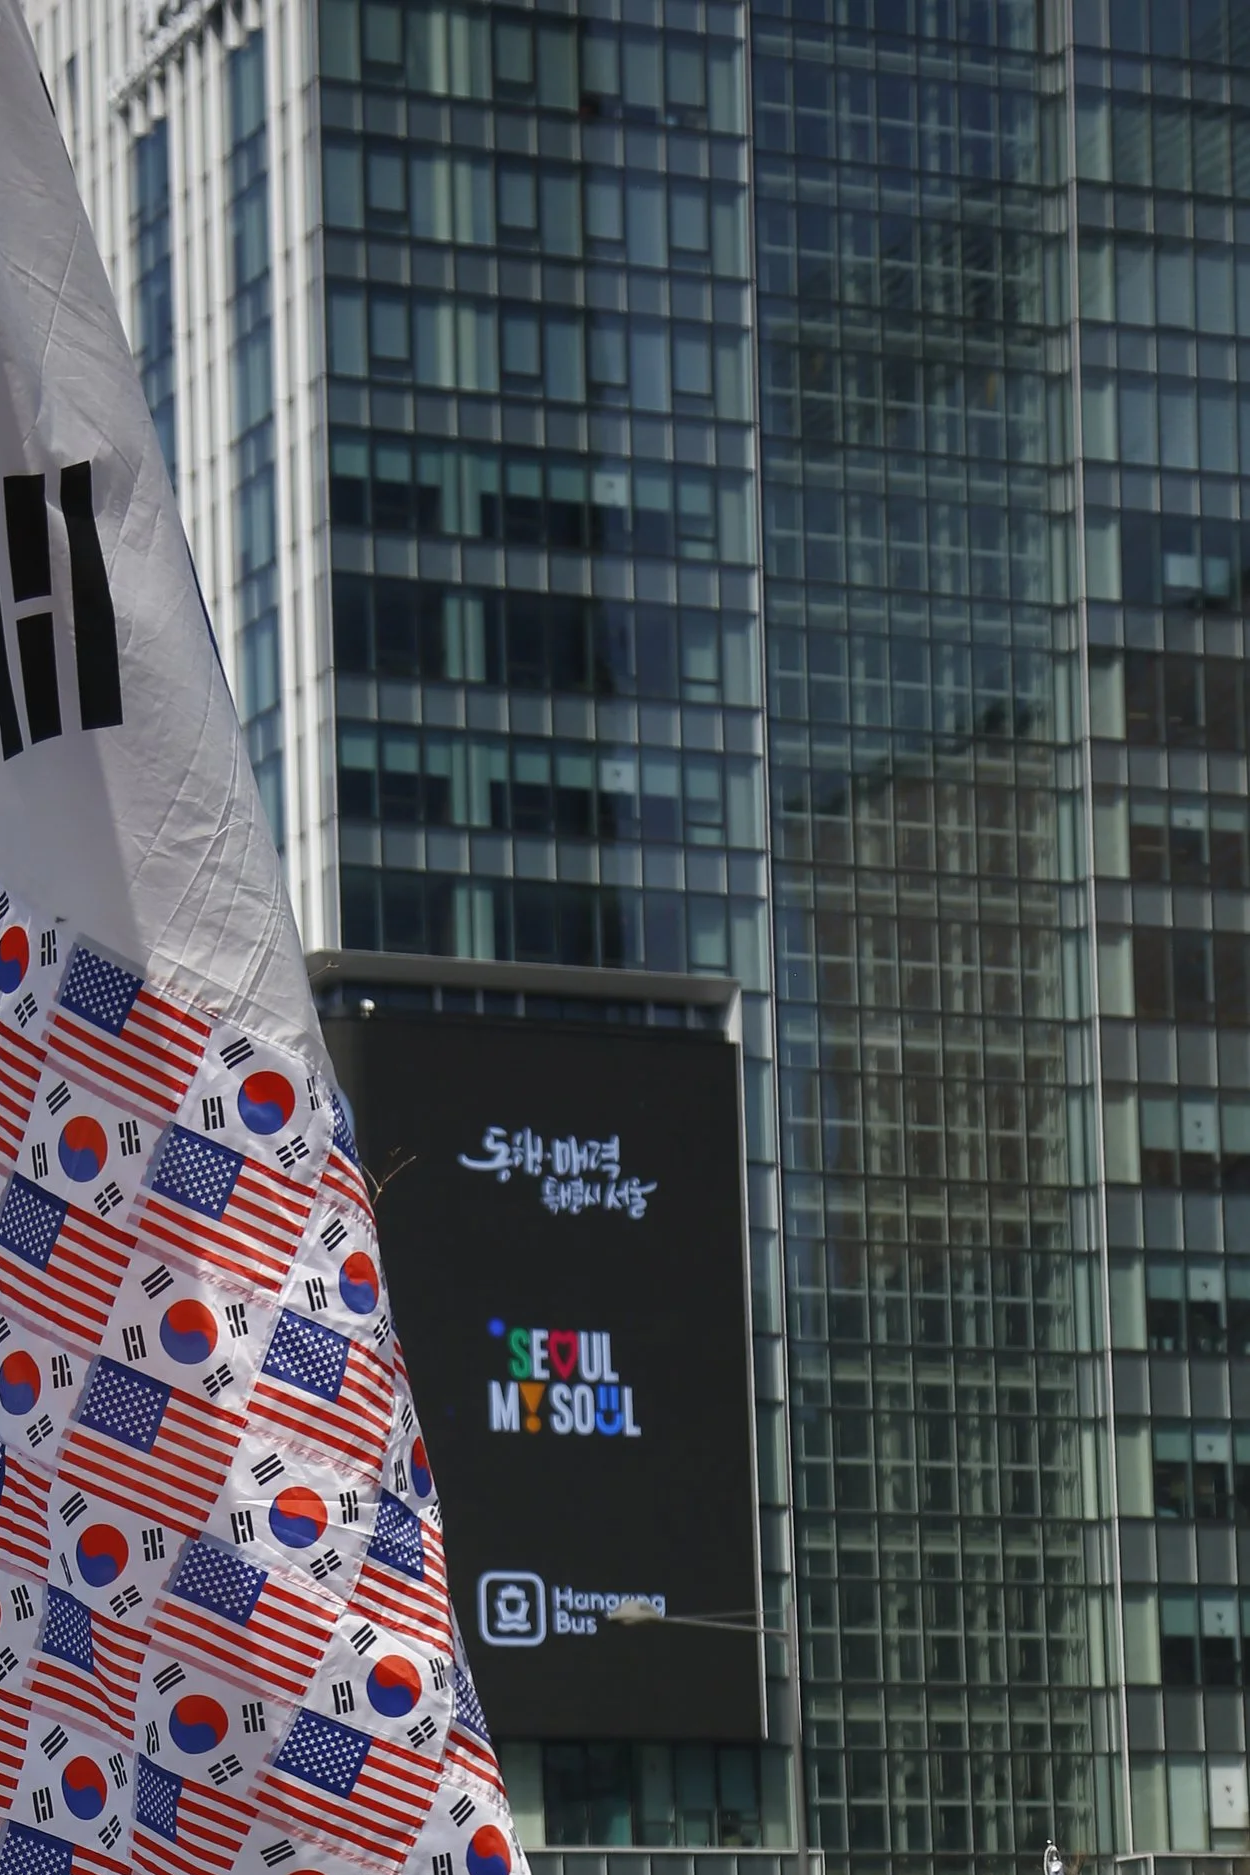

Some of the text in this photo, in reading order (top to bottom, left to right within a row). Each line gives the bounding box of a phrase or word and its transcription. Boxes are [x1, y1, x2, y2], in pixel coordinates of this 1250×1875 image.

[541, 1175, 658, 1220] 특별시 서울
[549, 1382, 642, 1437] SOUL
[554, 1609, 598, 1635] Bus
